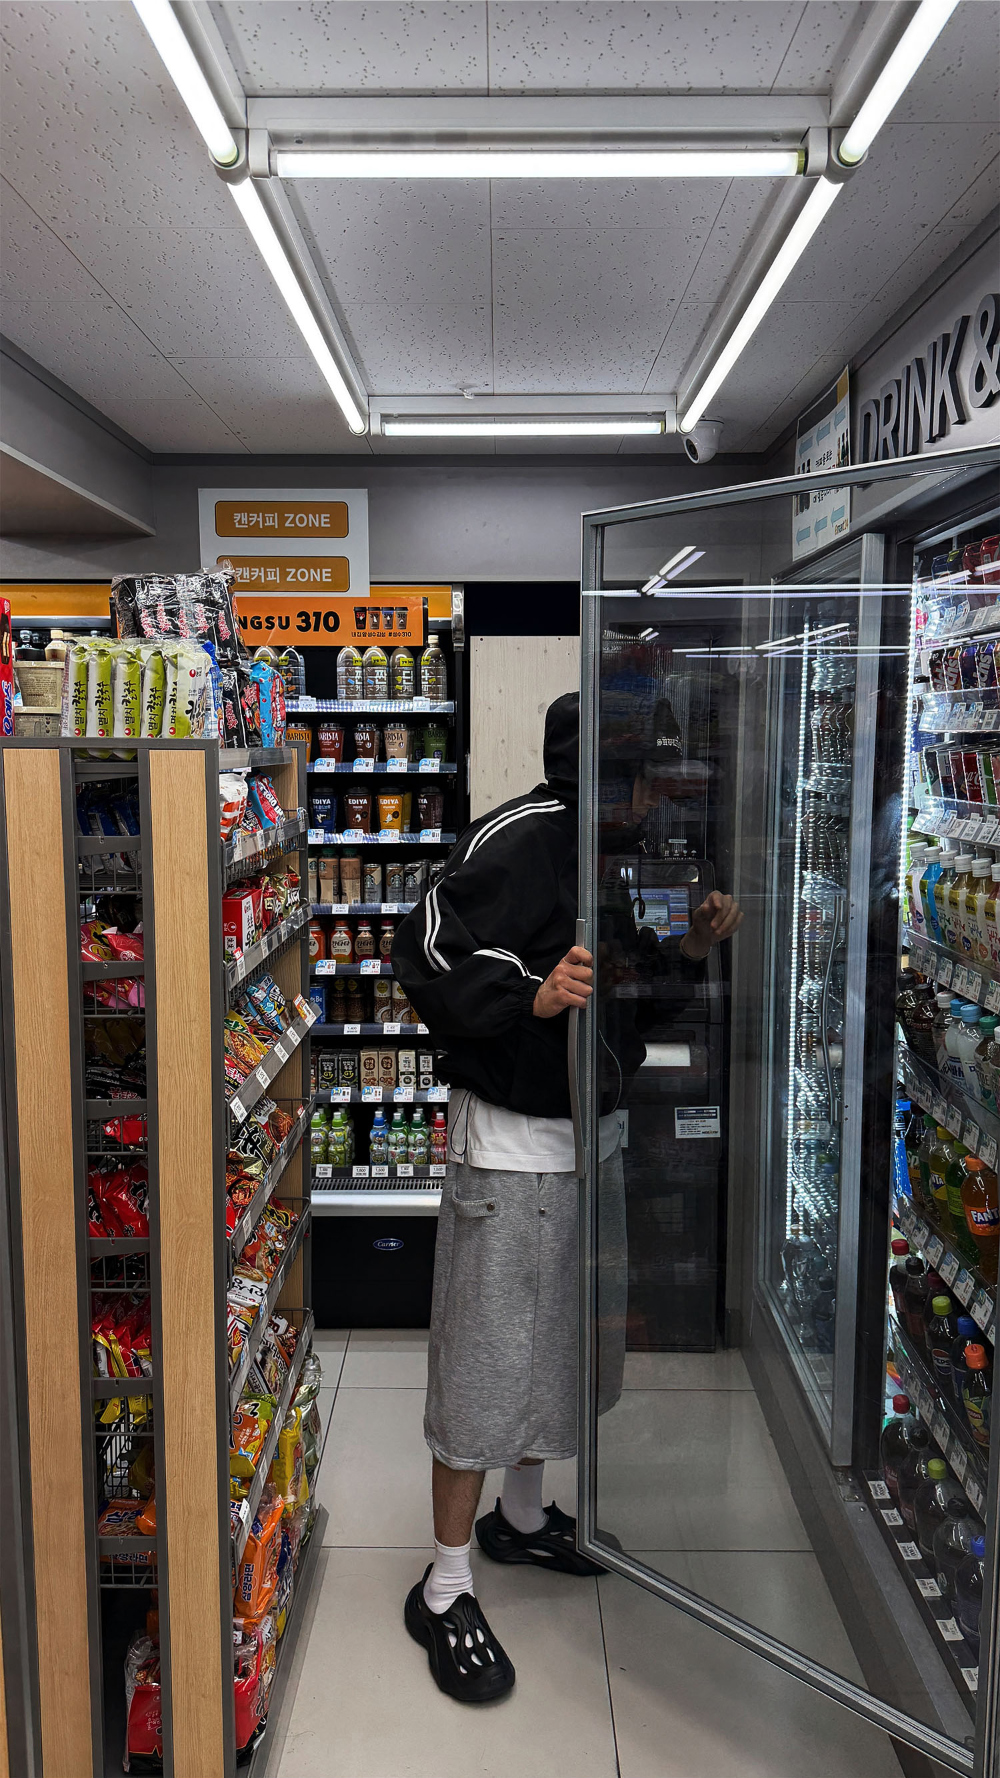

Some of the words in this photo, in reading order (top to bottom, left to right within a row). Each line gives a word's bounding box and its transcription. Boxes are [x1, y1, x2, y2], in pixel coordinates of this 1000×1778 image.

[860, 315, 970, 464] DRINK
[233, 512, 278, 529] 캔커피
[284, 513, 331, 528] ZONE
[235, 567, 280, 584] 캔커피
[286, 568, 332, 582] ZONE
[296, 610, 340, 633] 310
[71, 680, 87, 725] 멸치칼국수
[94, 681, 111, 726] 멸치칼국수
[121, 680, 138, 725] 멸치칼국수
[146, 686, 163, 731] 멸치칼국수
